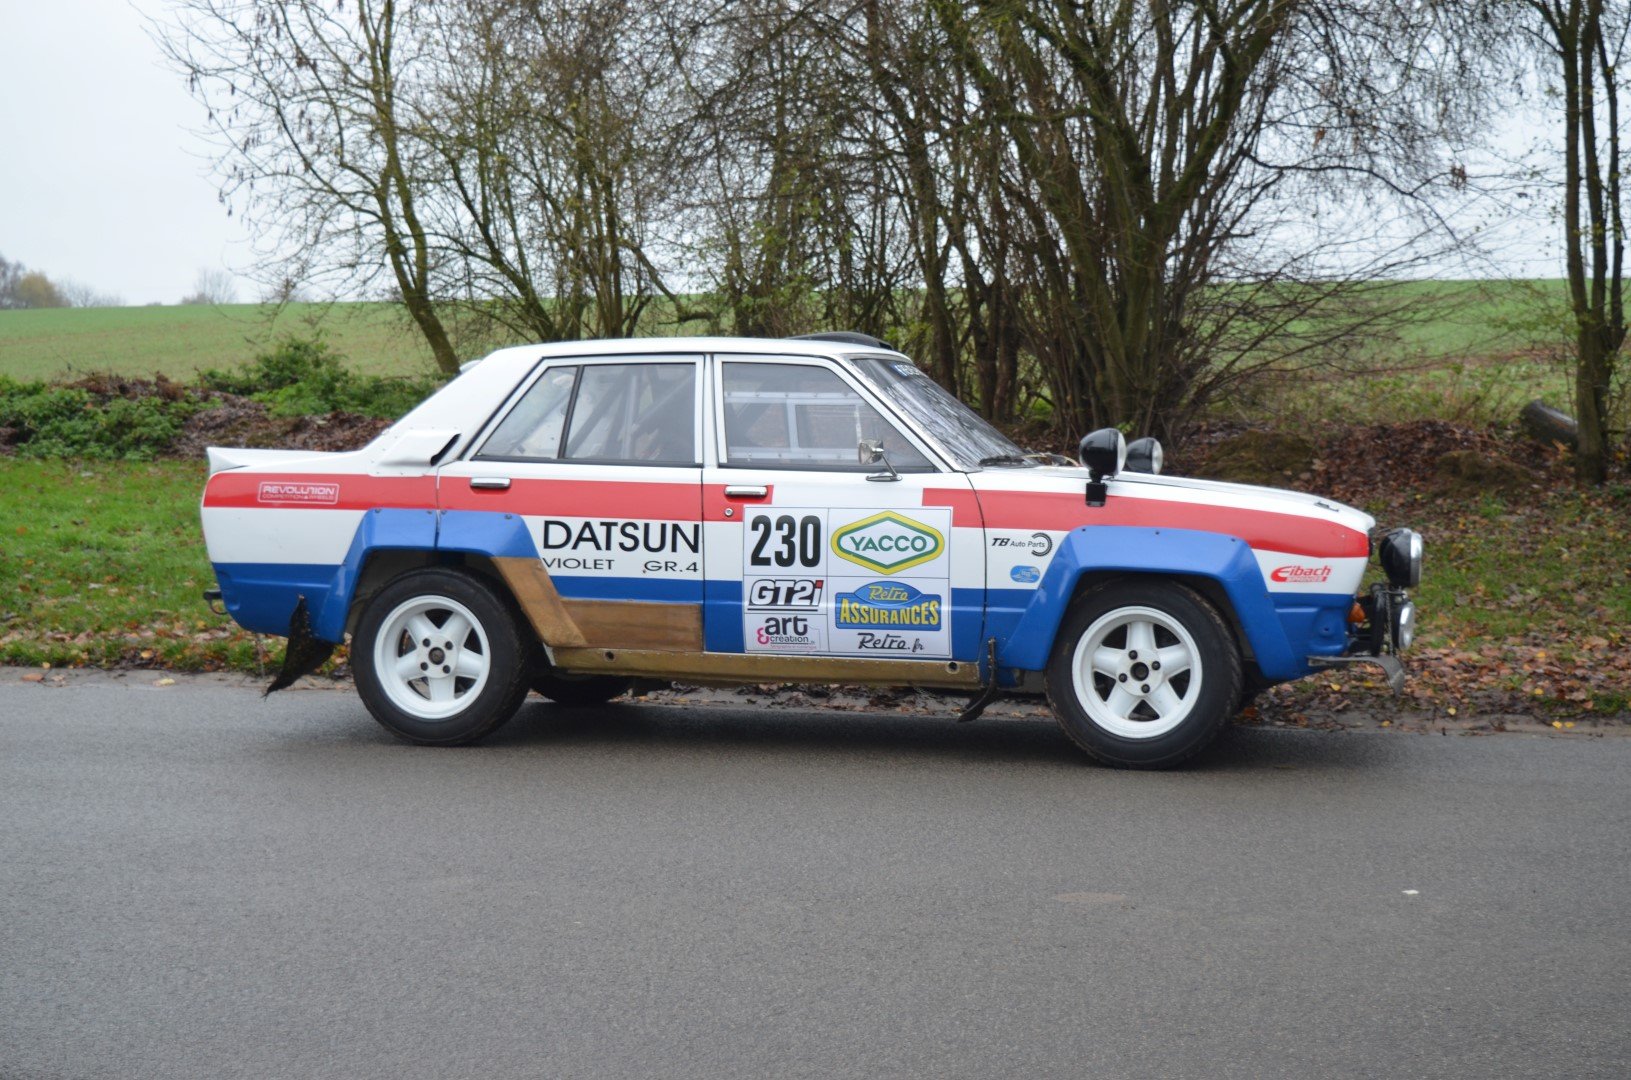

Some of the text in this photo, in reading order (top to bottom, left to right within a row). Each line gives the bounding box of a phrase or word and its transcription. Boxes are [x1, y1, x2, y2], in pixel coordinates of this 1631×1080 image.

[263, 486, 335, 495] REVOLUTION
[543, 520, 700, 553] DATSUN
[751, 515, 821, 567] 230
[849, 535, 927, 552] YACCO
[992, 537, 1045, 548] TB Auto Parts
[542, 558, 699, 573] VIOLET GR.4
[1271, 565, 1331, 582] Eibach
[749, 579, 824, 607] GT2i
[869, 586, 909, 601] Retro
[840, 598, 939, 625] ASSURANCES
[765, 616, 808, 636] art
